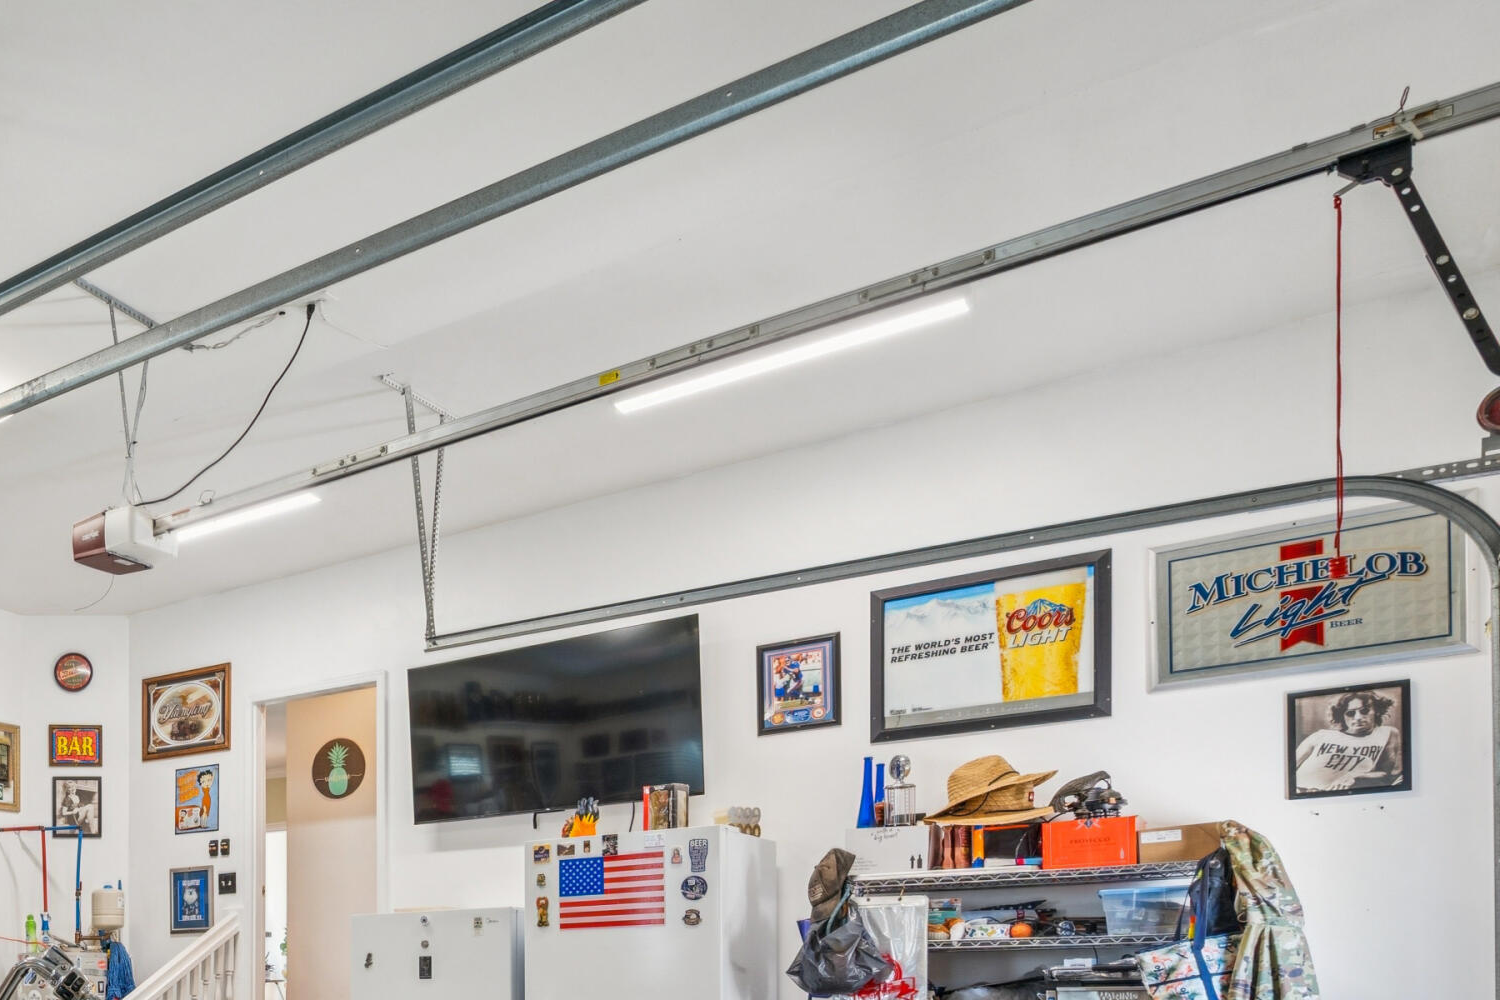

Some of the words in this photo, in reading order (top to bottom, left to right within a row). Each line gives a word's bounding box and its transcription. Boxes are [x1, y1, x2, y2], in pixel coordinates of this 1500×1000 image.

[1185, 550, 1428, 615] MICHELOB
[1230, 574, 1386, 641] Light
[1005, 607, 1077, 635] Coors
[1330, 617, 1364, 630] BEER
[890, 645, 911, 655] THE
[914, 637, 961, 651] WORLD'S
[964, 632, 995, 644] MOST
[1007, 626, 1073, 649] LIGHT
[890, 647, 957, 663] REFRESHING
[158, 699, 213, 725] Yuengling
[56, 736, 95, 757] BAR
[1319, 742, 1346, 756] NEW
[1352, 742, 1383, 759] YORK
[1325, 753, 1366, 772] CITY
[689, 839, 708, 847] BEER
